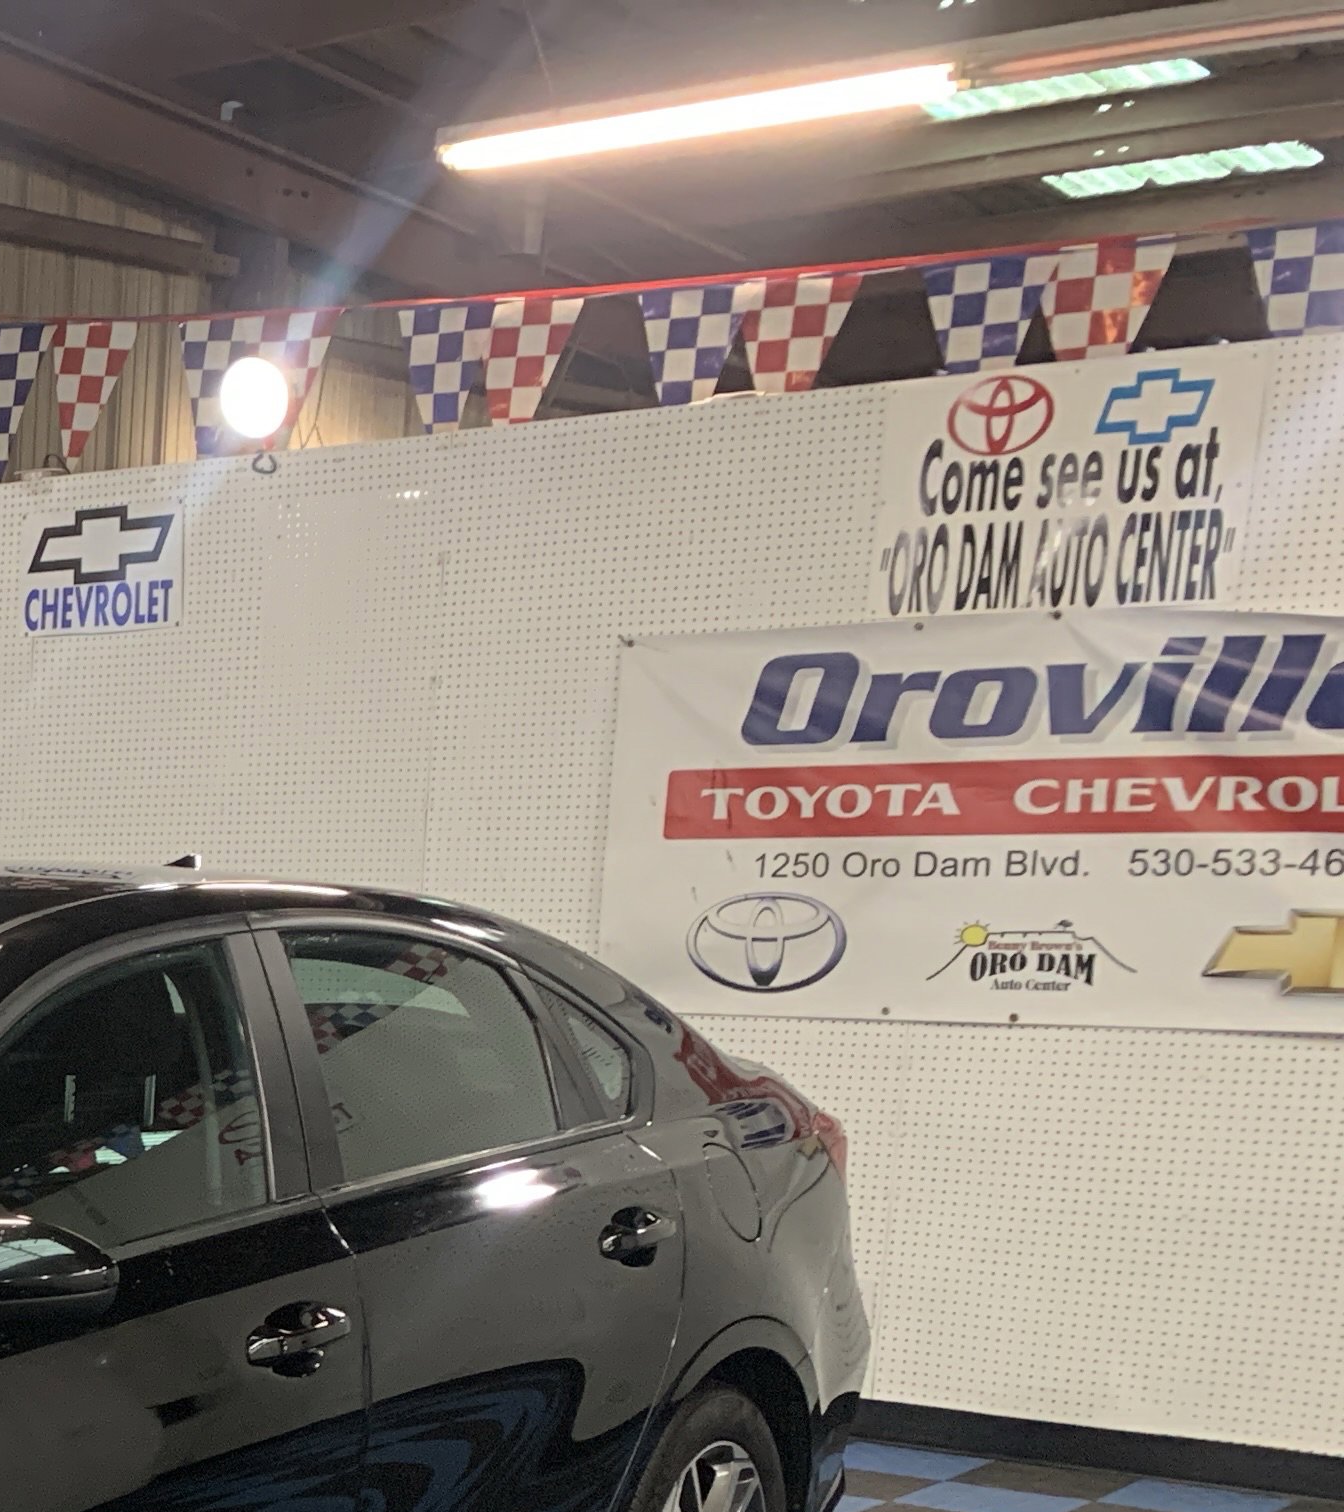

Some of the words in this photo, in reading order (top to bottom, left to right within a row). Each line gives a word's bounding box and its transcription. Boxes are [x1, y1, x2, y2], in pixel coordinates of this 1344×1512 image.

[919, 439, 1024, 516] Come
[1036, 450, 1103, 508] see
[1117, 446, 1163, 503] us
[1175, 427, 1224, 503] at,
[880, 523, 949, 616] "ORO
[954, 521, 1024, 611] DAM
[1021, 513, 1109, 608] AUTO
[1115, 508, 1236, 604] CENTER"
[25, 579, 173, 631] CHEVROLET
[700, 782, 961, 820] TOYOTA
[754, 852, 830, 879] 1250
[842, 851, 901, 879] Oro
[914, 850, 991, 878] Dam
[1005, 849, 1091, 878] Blvd.
[970, 951, 1027, 981] ORO
[1036, 952, 1097, 986] DAM
[990, 979, 1022, 991] Auto
[1025, 979, 1071, 991] Center
